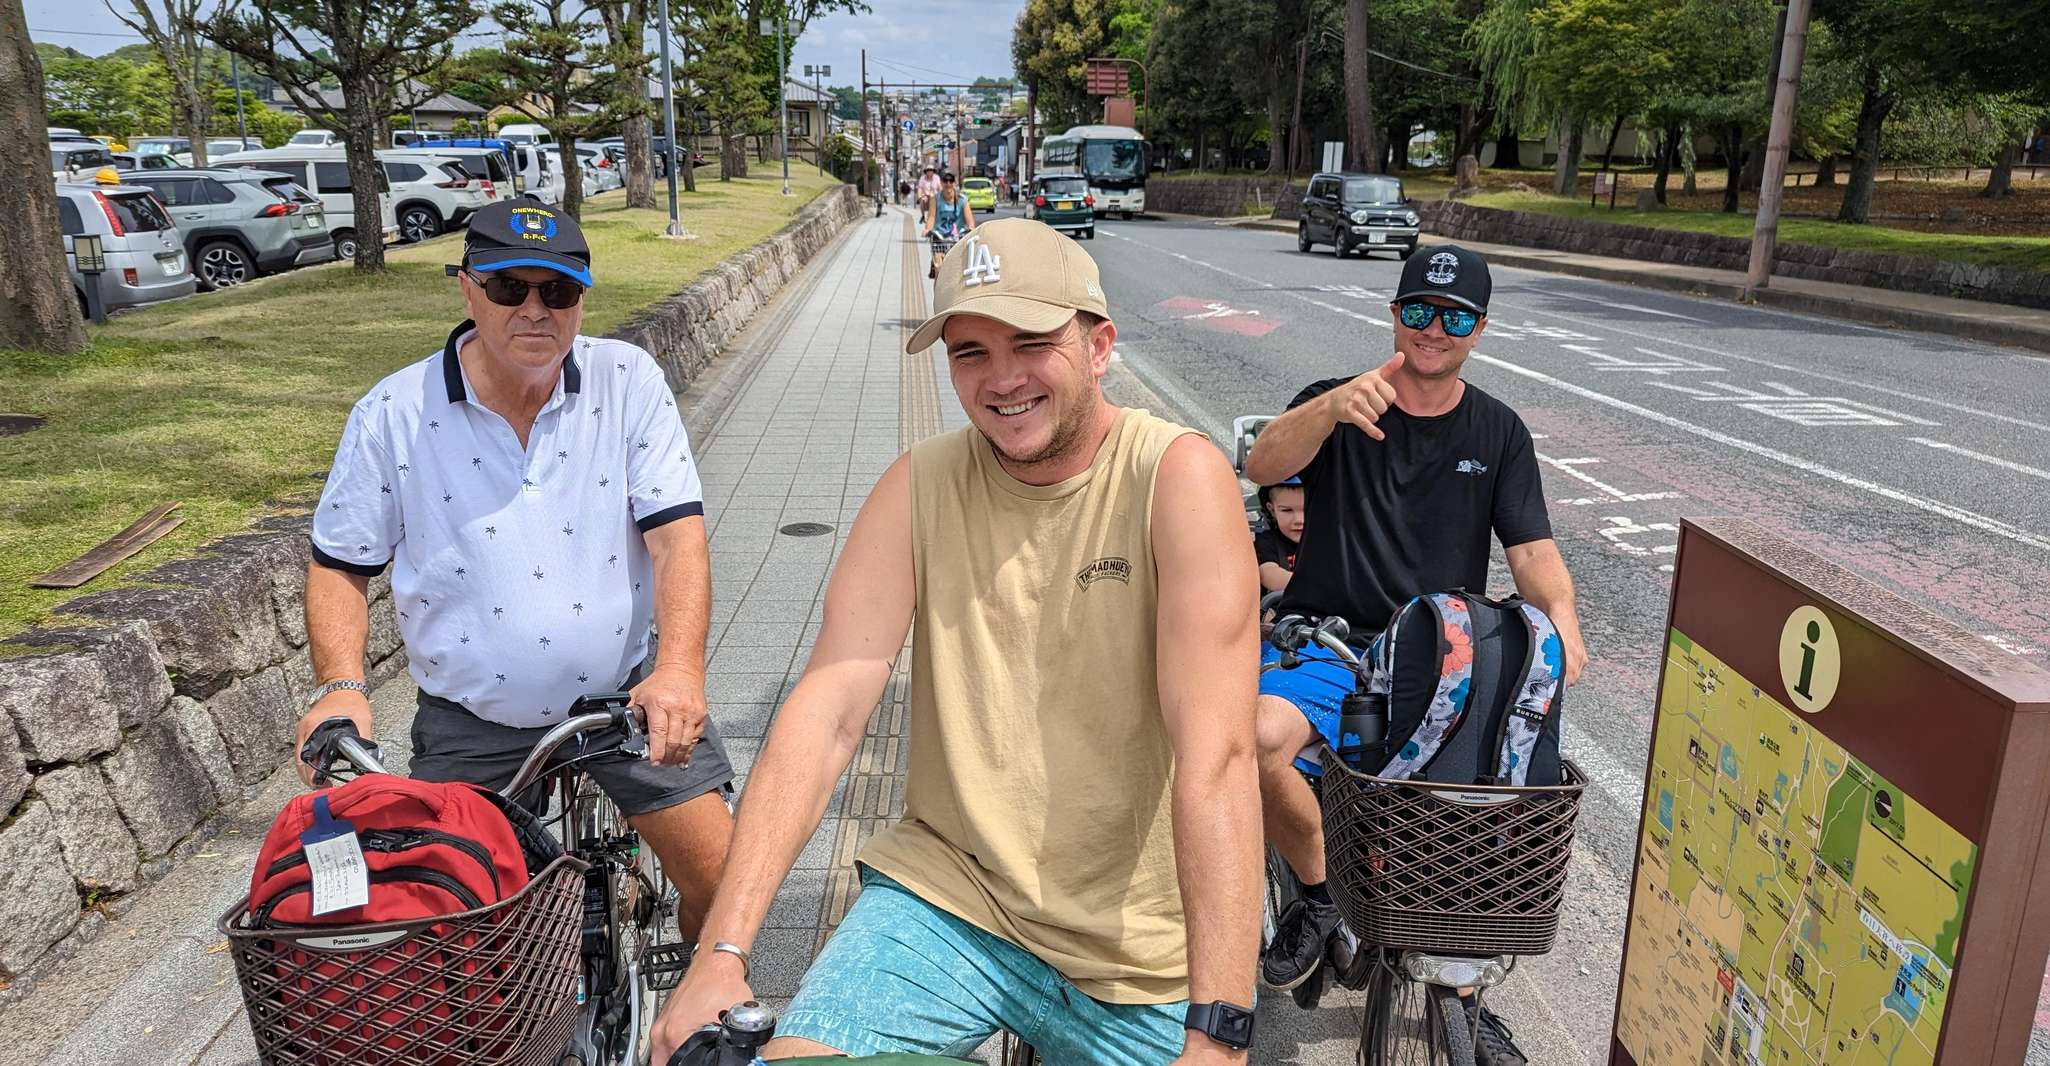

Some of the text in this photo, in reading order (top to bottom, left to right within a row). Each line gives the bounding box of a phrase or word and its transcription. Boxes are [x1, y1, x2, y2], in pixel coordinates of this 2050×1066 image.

[964, 235, 1000, 286] LA
[1516, 708, 1543, 720] BURTON
[1460, 793, 1490, 801] Panasonic
[333, 936, 370, 945] Panasonic
